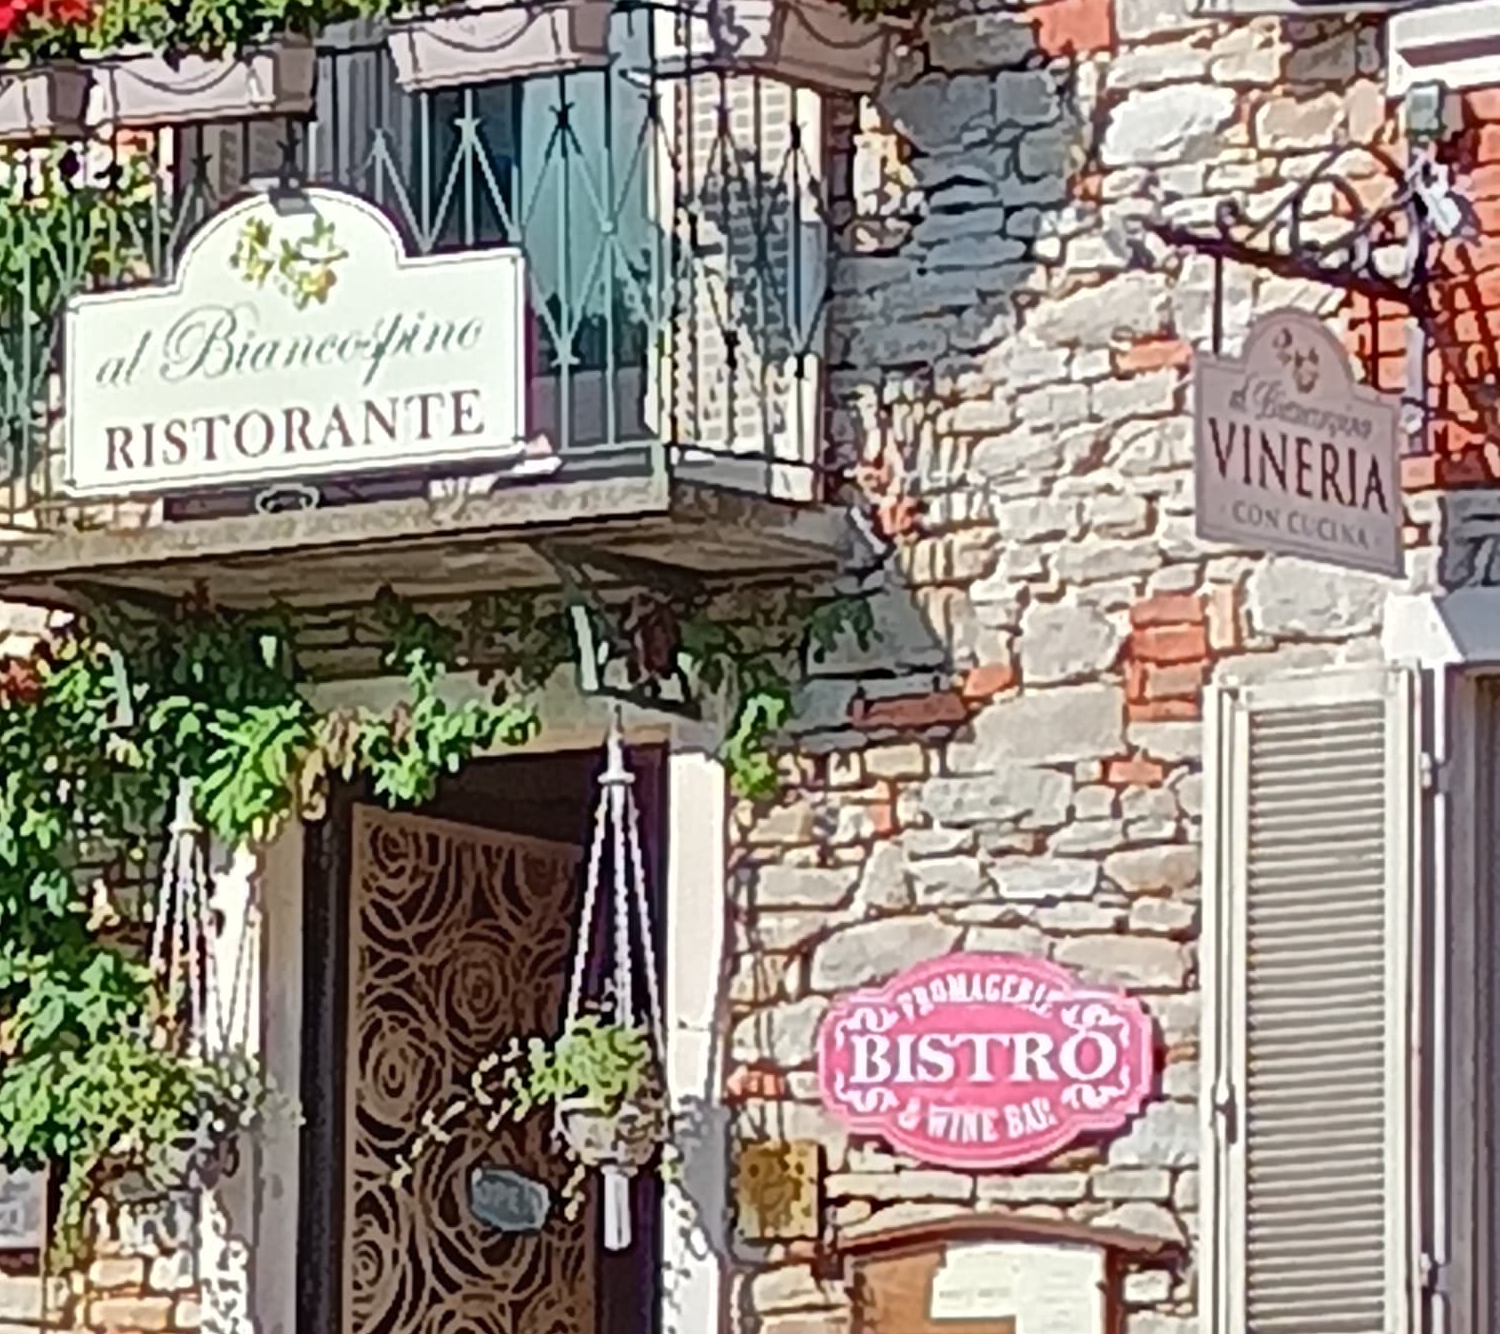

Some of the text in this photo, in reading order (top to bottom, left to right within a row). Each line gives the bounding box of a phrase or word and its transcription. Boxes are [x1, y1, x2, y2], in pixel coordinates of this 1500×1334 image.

[96, 303, 484, 389] al Biancospino
[104, 387, 485, 472] RISTORANTE
[1208, 415, 1388, 515] VINERIA
[1232, 498, 1370, 551] CON CUCINA
[896, 973, 1060, 1021] FROMAGERIE
[928, 1104, 1000, 1143] WINE
[1004, 1096, 1059, 1139] BAR
